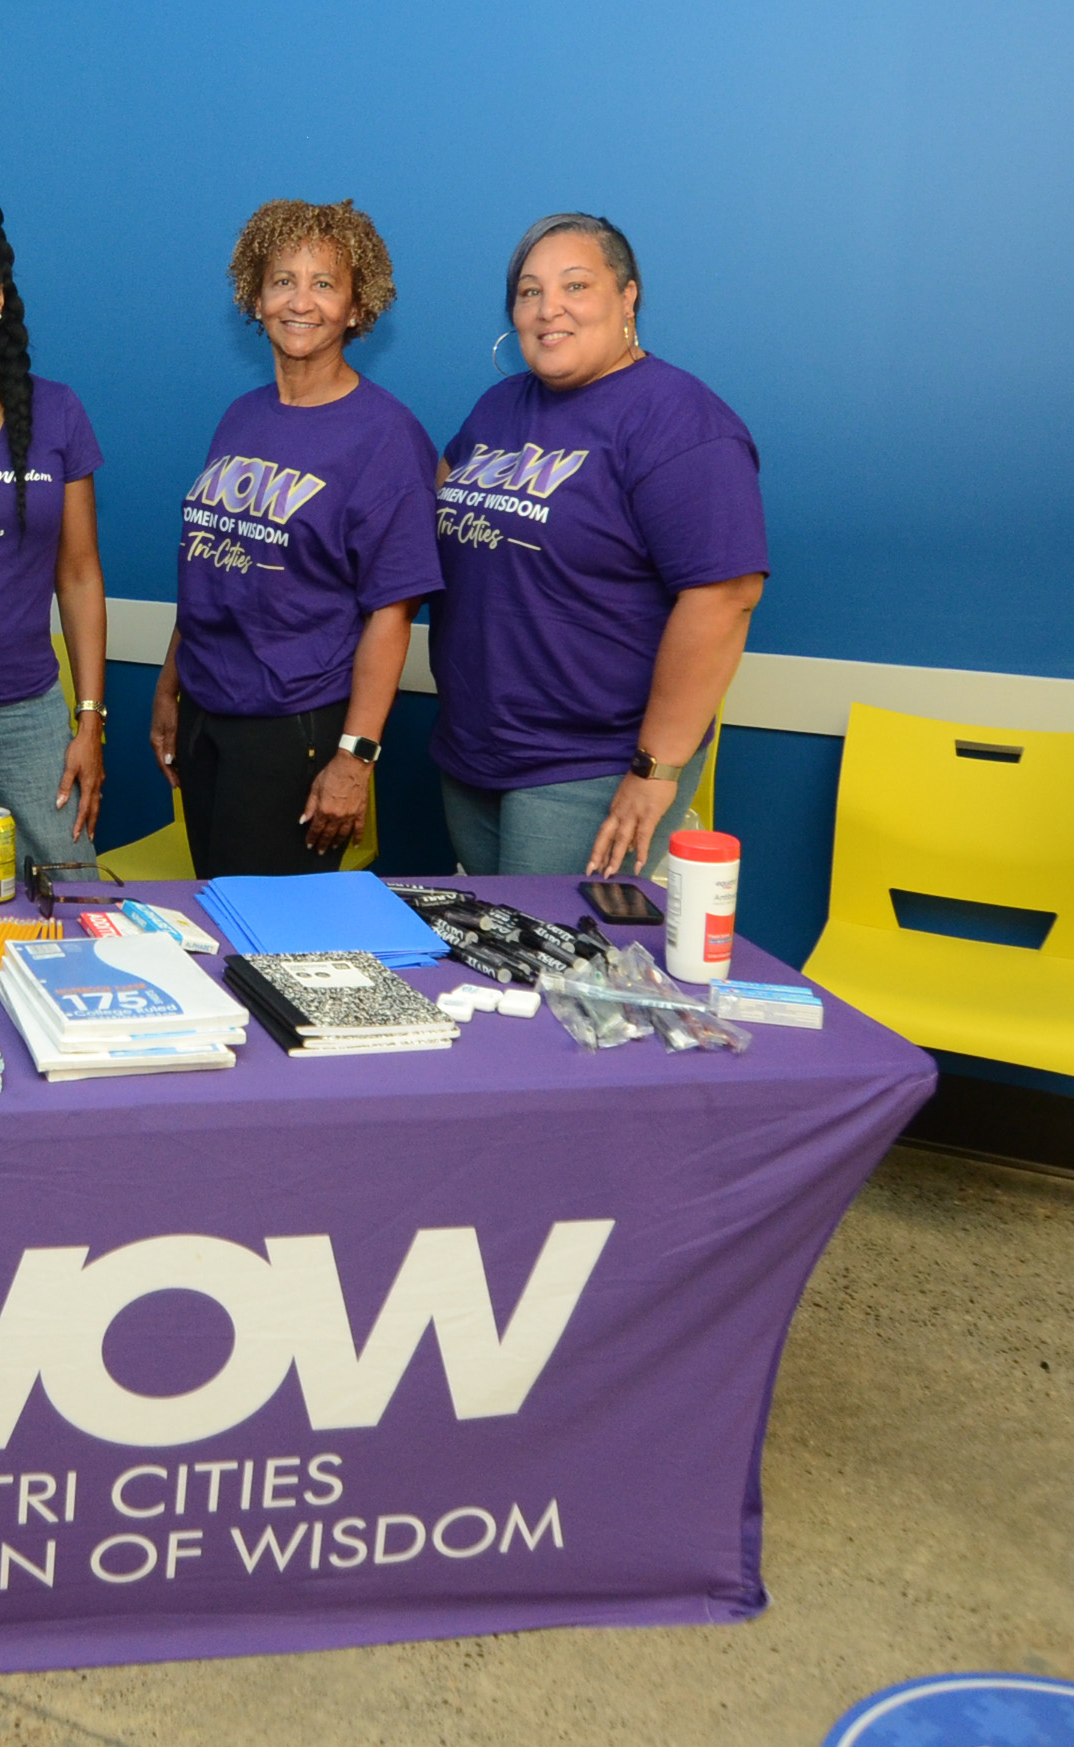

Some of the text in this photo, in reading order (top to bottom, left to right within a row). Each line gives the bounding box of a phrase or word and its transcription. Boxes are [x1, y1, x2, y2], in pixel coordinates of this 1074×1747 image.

[186, 455, 327, 525] WOW
[437, 486, 550, 524] OMEN OF WISDOM
[183, 506, 290, 547] OMEN OF WISDOM
[437, 507, 504, 550] Tri-Cities
[188, 531, 253, 574] Tri-Cities
[61, 989, 148, 1012] 175
[73, 1007, 136, 1019] College
[137, 1003, 178, 1016] Ruled
[111, 1453, 344, 1518] CITIES
[89, 1530, 206, 1584] OF
[230, 1498, 564, 1573] WISDOM
